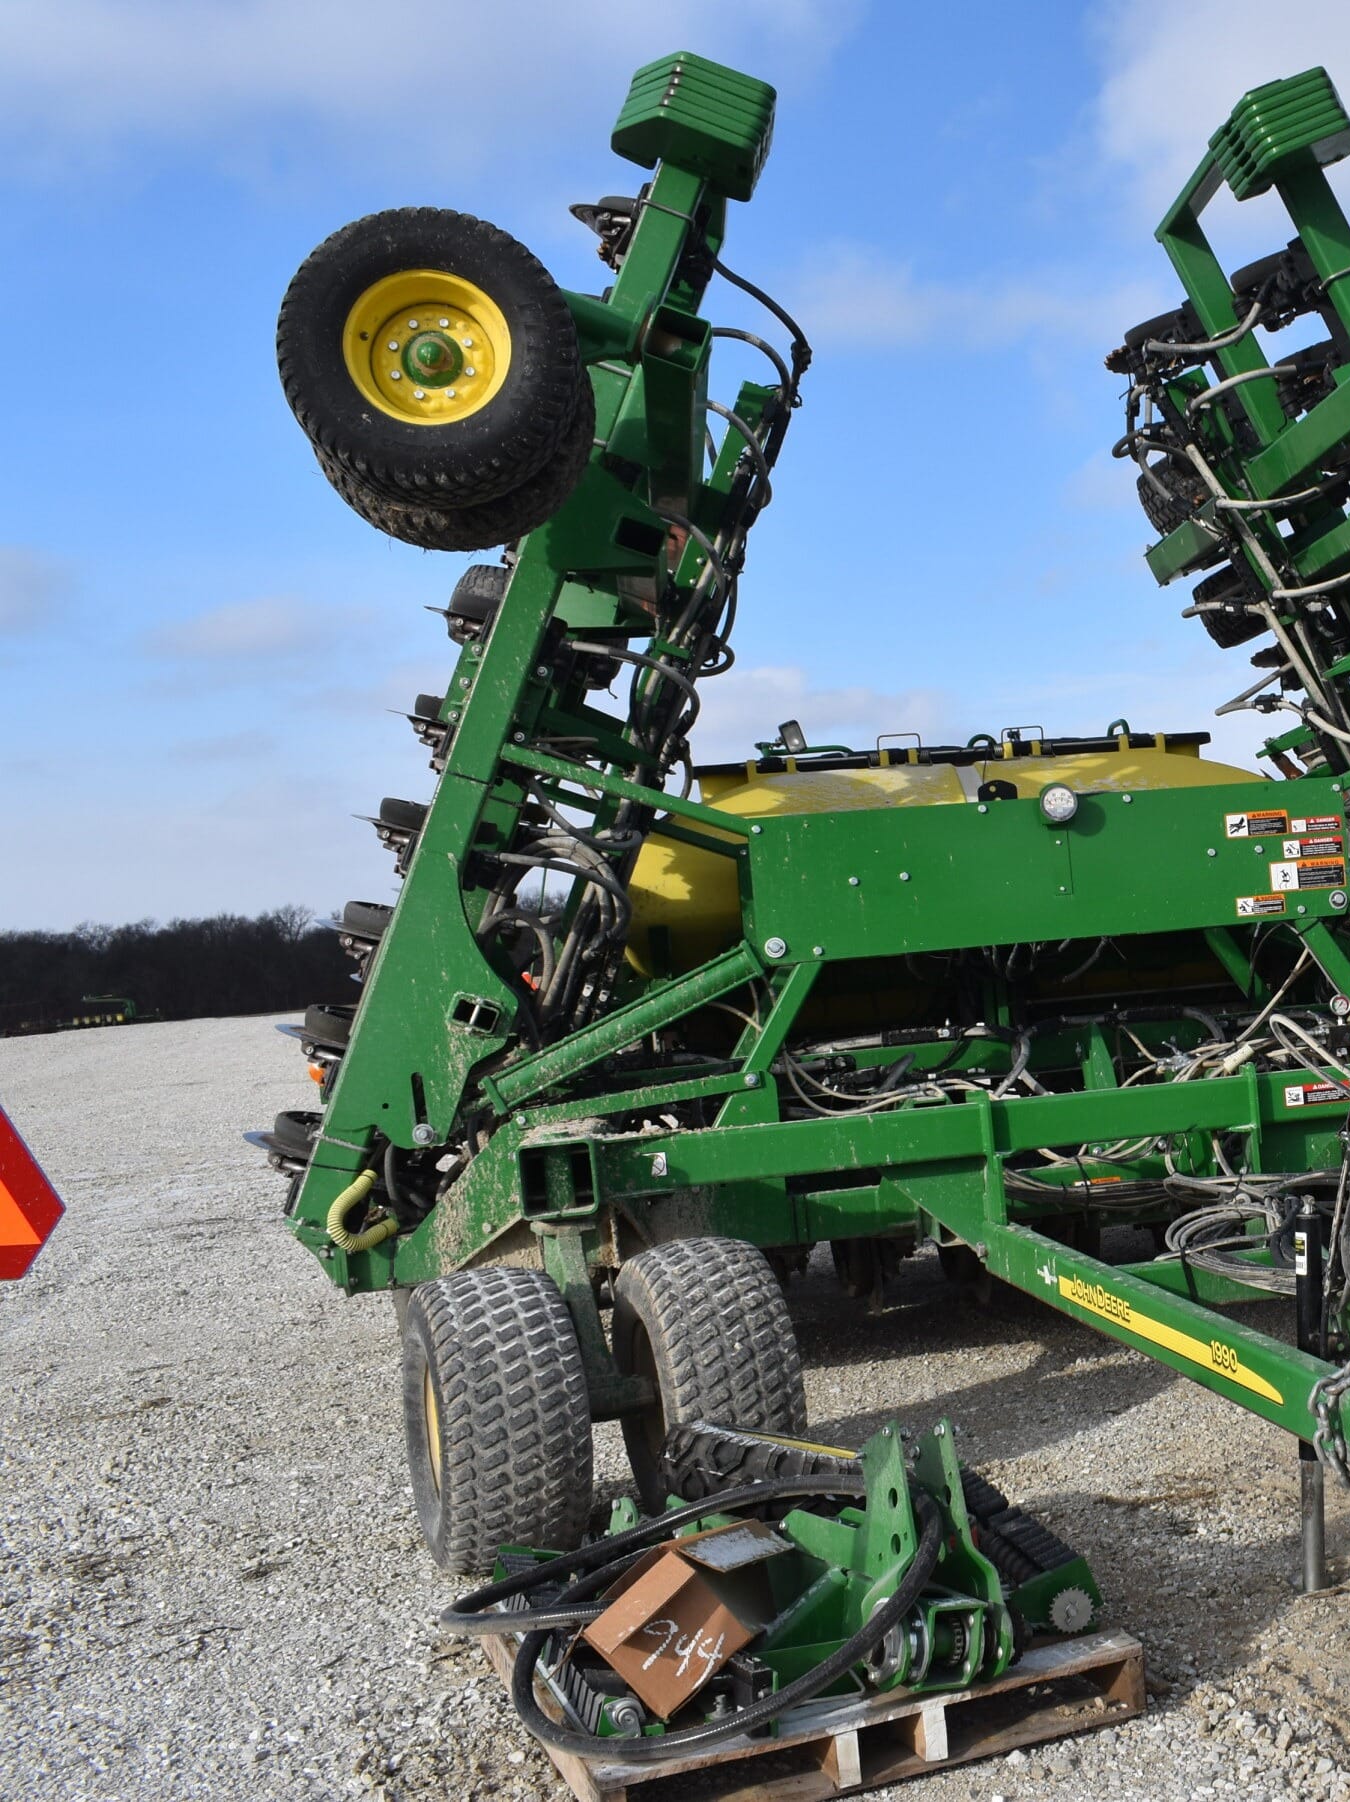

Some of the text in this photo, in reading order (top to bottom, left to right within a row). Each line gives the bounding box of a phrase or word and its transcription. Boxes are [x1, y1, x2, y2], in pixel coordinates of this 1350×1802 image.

[1071, 1273, 1131, 1323] JOHN DEERE
[1210, 1340, 1238, 1373] 1990
